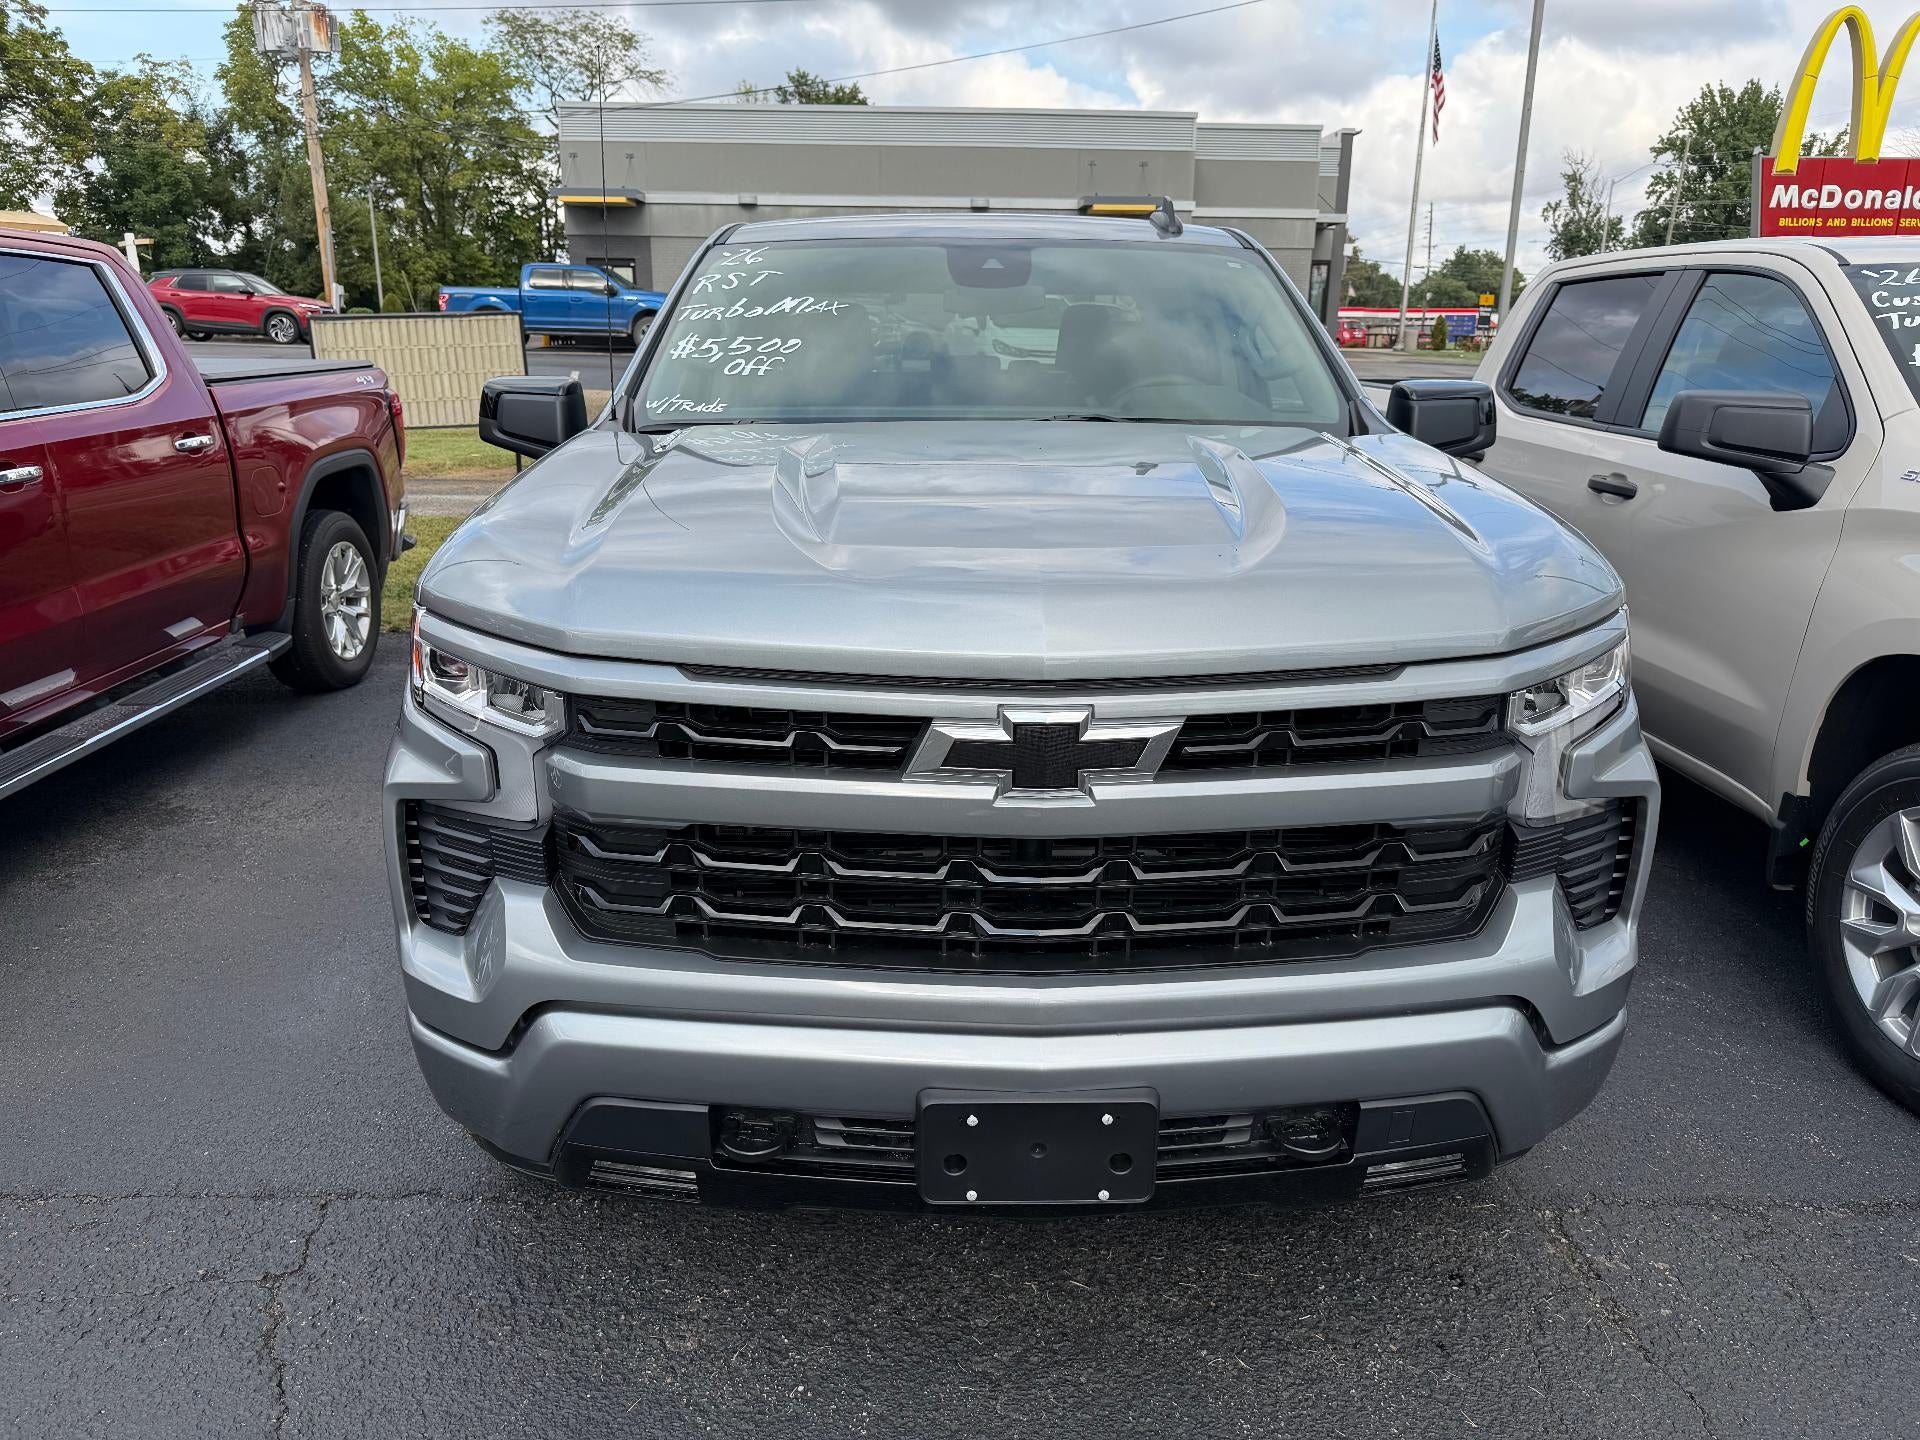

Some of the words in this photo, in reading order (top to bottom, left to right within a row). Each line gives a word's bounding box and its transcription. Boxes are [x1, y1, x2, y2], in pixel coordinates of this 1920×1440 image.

[1778, 217, 1823, 227] BILLIONS
[1826, 217, 1847, 227] AND
[1851, 217, 1894, 227] BILLIONS
[670, 332, 802, 363] $5,500
[723, 356, 786, 376] Off
